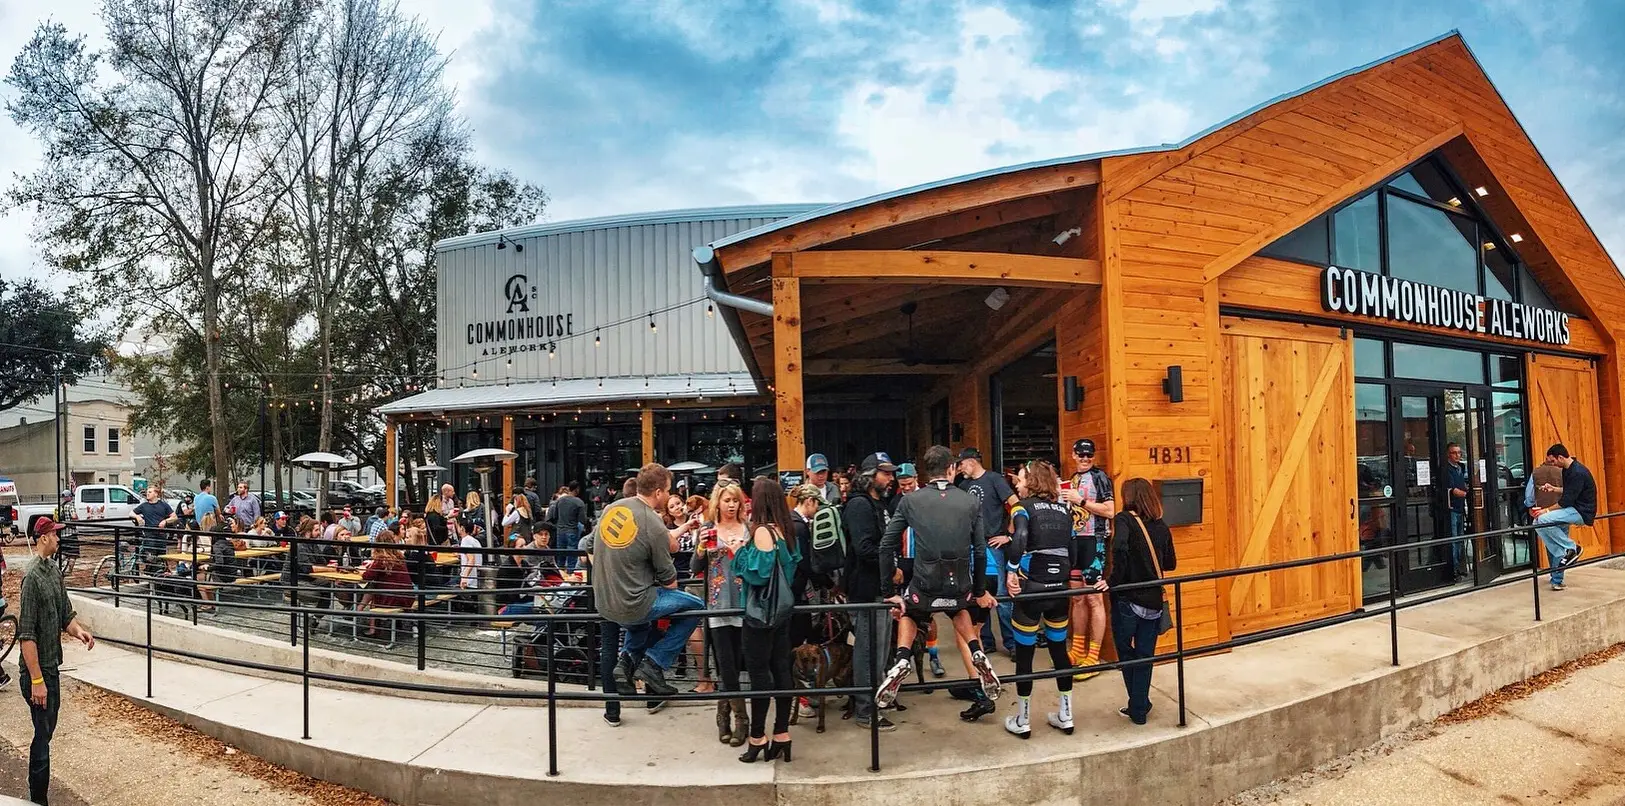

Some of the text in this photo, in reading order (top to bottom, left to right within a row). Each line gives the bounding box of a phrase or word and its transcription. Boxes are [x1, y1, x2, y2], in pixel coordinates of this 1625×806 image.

[1326, 266, 1570, 345] COMMONHOUSE ALEWORKS
[467, 313, 573, 345] COMMONHOUSE
[482, 342, 557, 356] ALEWORKS
[1149, 446, 1190, 464] 4831
[1033, 502, 1051, 511] HIGH
